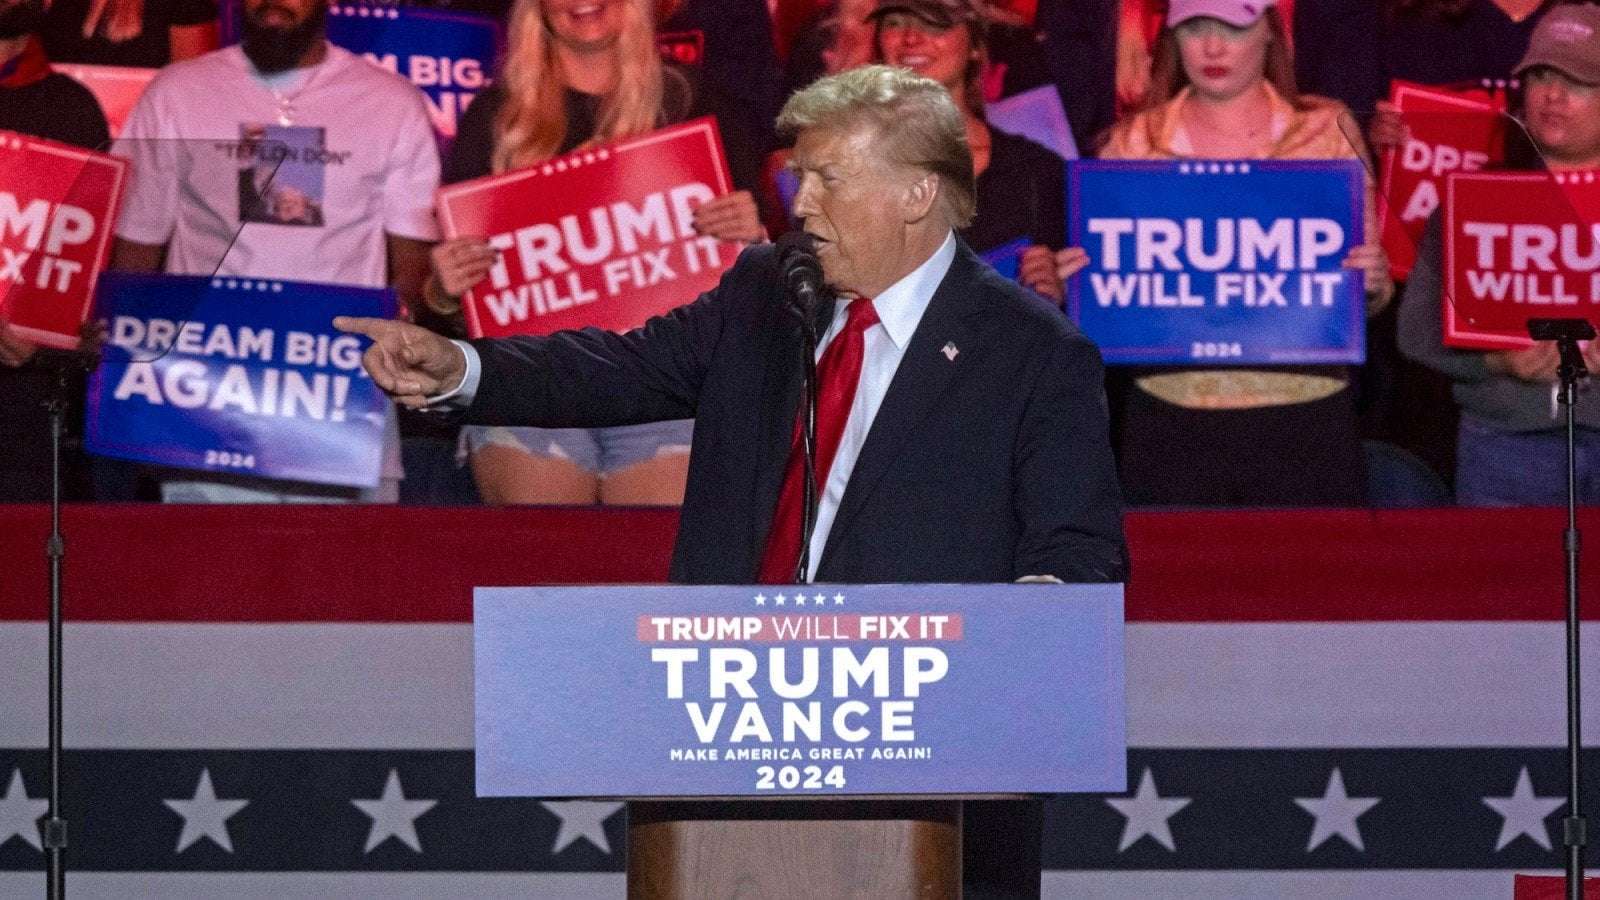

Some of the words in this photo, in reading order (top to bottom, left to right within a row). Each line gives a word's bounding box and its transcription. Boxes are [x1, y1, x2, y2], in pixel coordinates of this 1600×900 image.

[1088, 217, 1345, 272] TRUMP
[36, 255, 83, 293] IT
[485, 273, 599, 326] WILL
[606, 241, 677, 296] FIX
[687, 237, 722, 273] IT
[1090, 273, 1205, 307] WILL
[1215, 273, 1288, 307] FIX
[1300, 273, 1343, 307] IT
[1466, 270, 1579, 305] WILL
[113, 315, 275, 361] DREAM
[1192, 342, 1242, 358] 2024
[113, 359, 350, 422] AGAIN!
[204, 450, 256, 469] 2024
[651, 616, 763, 641] TRUMP
[771, 616, 850, 640] WILL
[859, 616, 911, 640] FIX
[919, 616, 949, 639] IT
[651, 647, 949, 699] TRUMP
[685, 701, 915, 743] VANCE
[670, 749, 718, 762] MAKE
[725, 748, 802, 761] AMERICA
[809, 748, 864, 761] GREAT
[871, 747, 932, 760] AGAIN!
[755, 765, 846, 790] 2024
